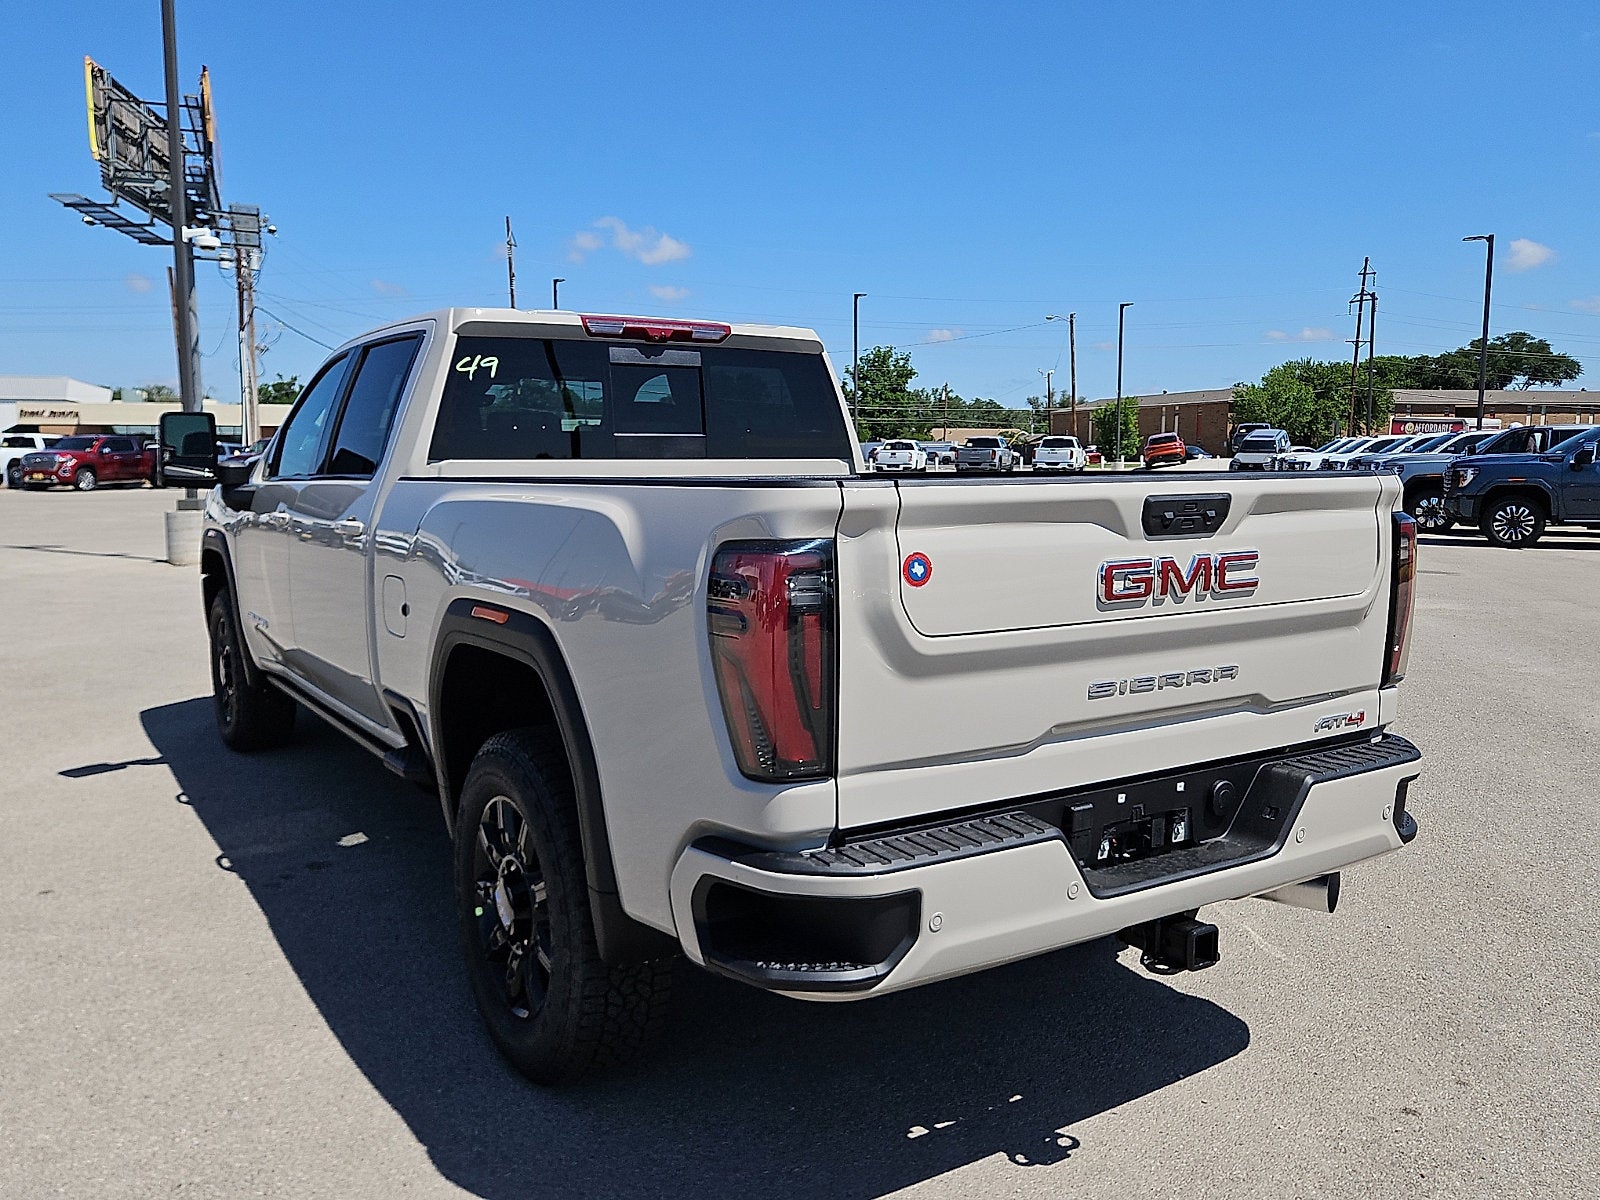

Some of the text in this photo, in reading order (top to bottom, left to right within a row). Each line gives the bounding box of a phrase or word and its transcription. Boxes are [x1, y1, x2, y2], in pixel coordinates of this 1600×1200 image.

[455, 354, 499, 381] 49
[1099, 550, 1260, 605] GMC
[1087, 665, 1240, 700] SIERRA
[1313, 710, 1365, 733] AT4
